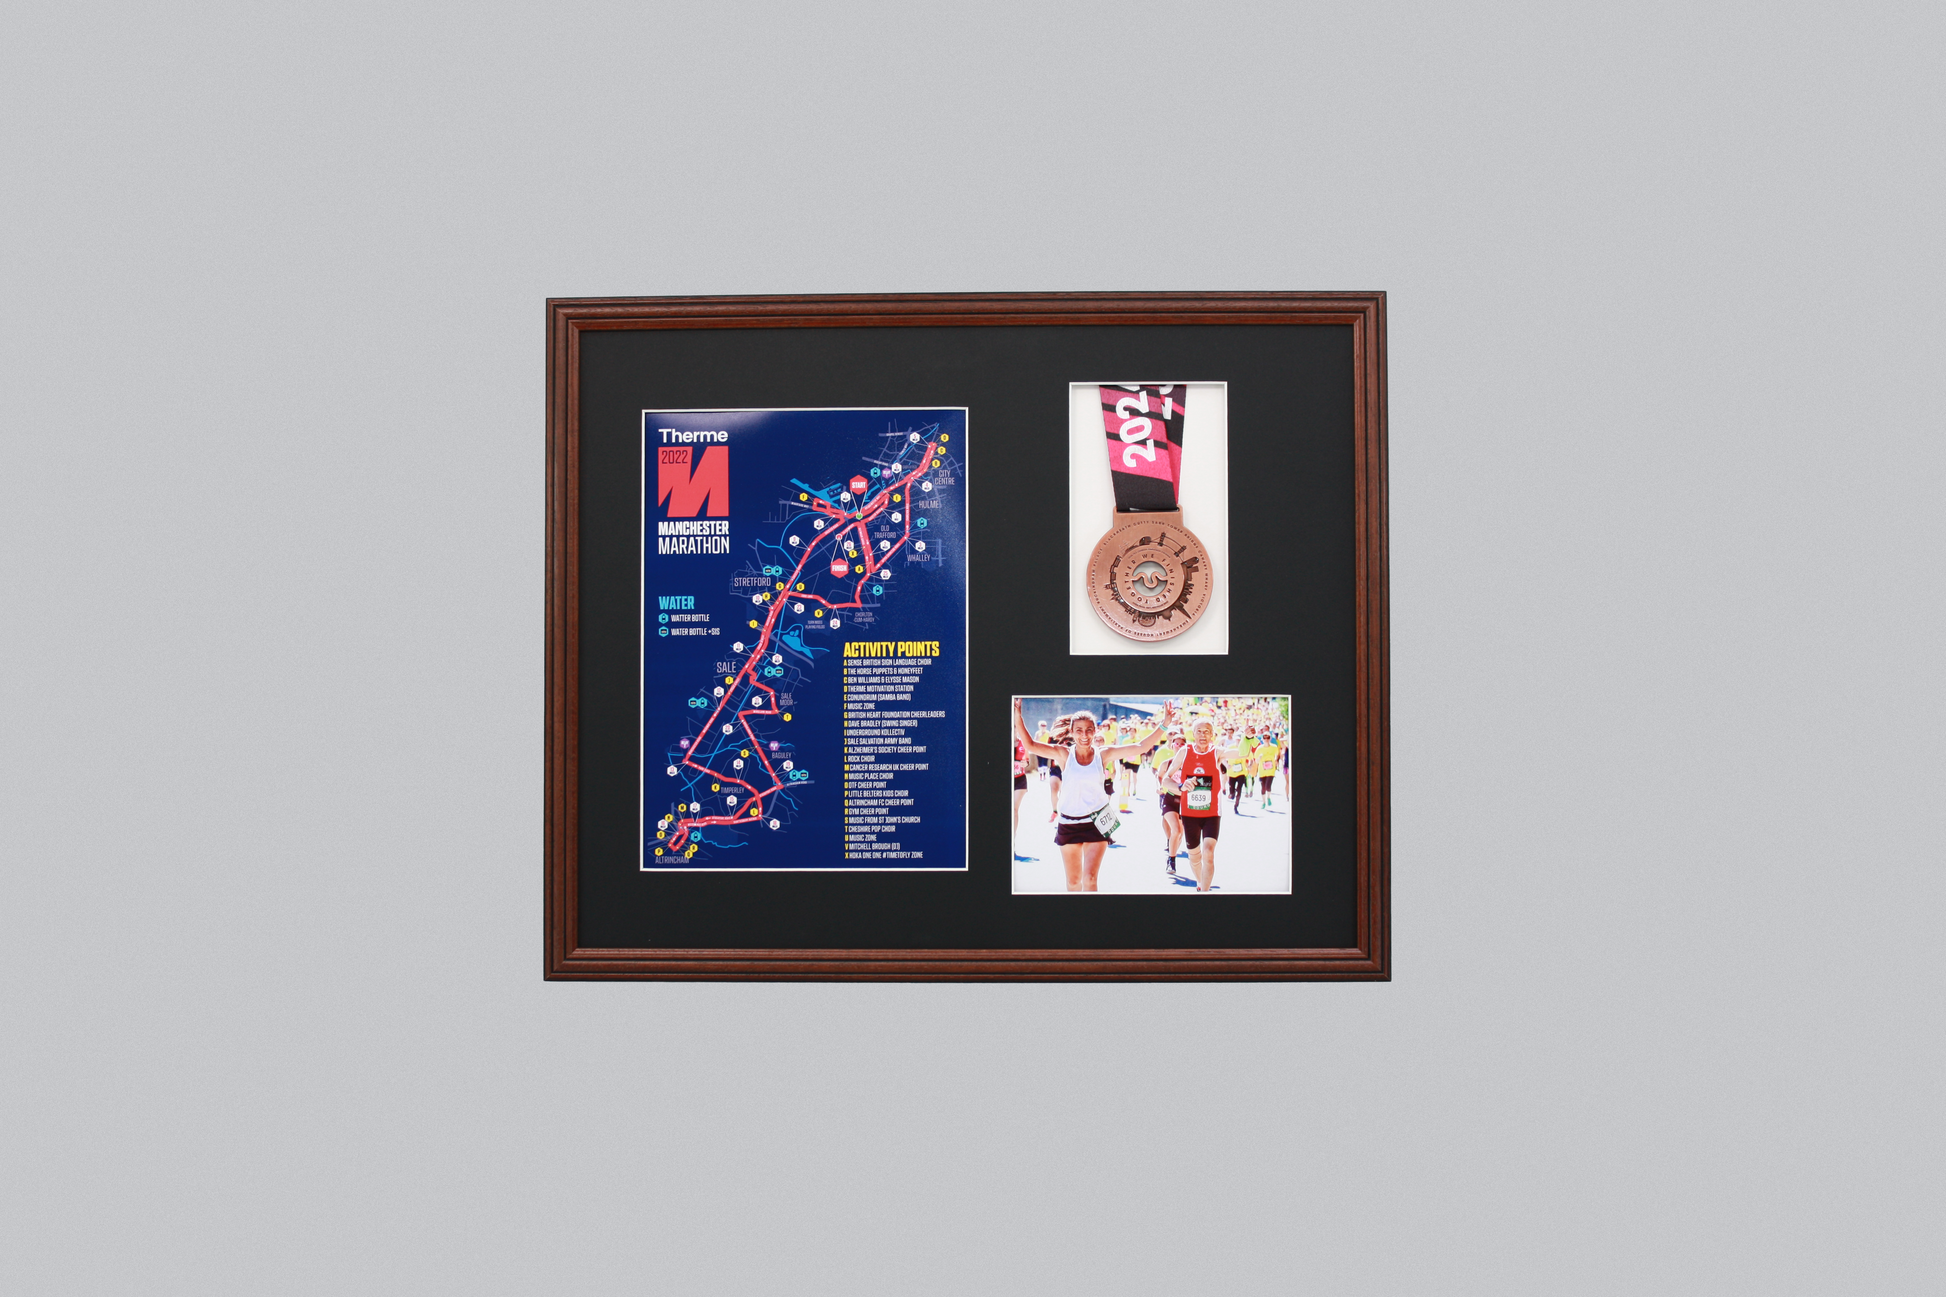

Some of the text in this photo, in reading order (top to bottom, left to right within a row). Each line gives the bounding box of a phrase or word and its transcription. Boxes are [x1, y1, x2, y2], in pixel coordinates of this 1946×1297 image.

[658, 428, 728, 443] Therme
[662, 450, 688, 464] 2022
[658, 521, 729, 536] MANCHESTER
[658, 536, 730, 554] MARATHON
[734, 577, 771, 586] STRETFORD
[1124, 559, 1148, 604] TOGETHER
[1155, 558, 1174, 602] FINISHED
[659, 596, 694, 610] WATER
[843, 641, 940, 657] ACTIVITY POINTS
[717, 662, 736, 673] SALE
